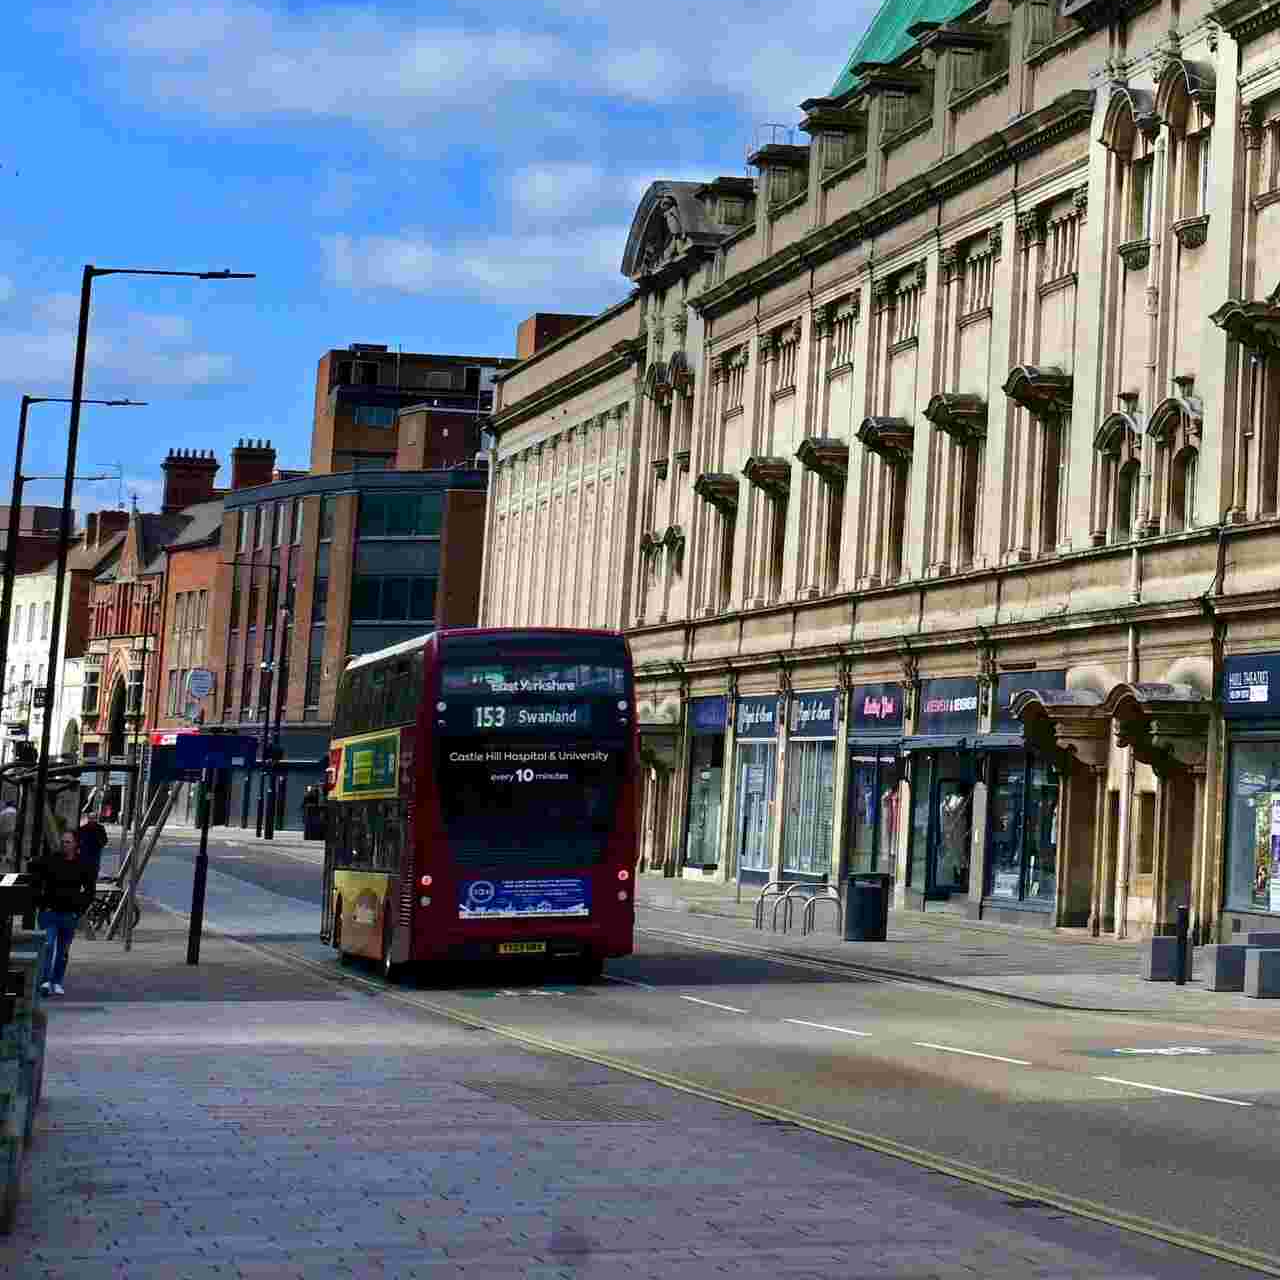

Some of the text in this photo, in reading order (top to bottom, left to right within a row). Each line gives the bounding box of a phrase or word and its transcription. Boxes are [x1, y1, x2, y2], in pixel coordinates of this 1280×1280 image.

[519, 680, 576, 692] Yorkshire
[475, 706, 576, 727] 153 Swanland
[449, 751, 608, 763] Castle Hill Hospital & University
[516, 769, 534, 782] 10
